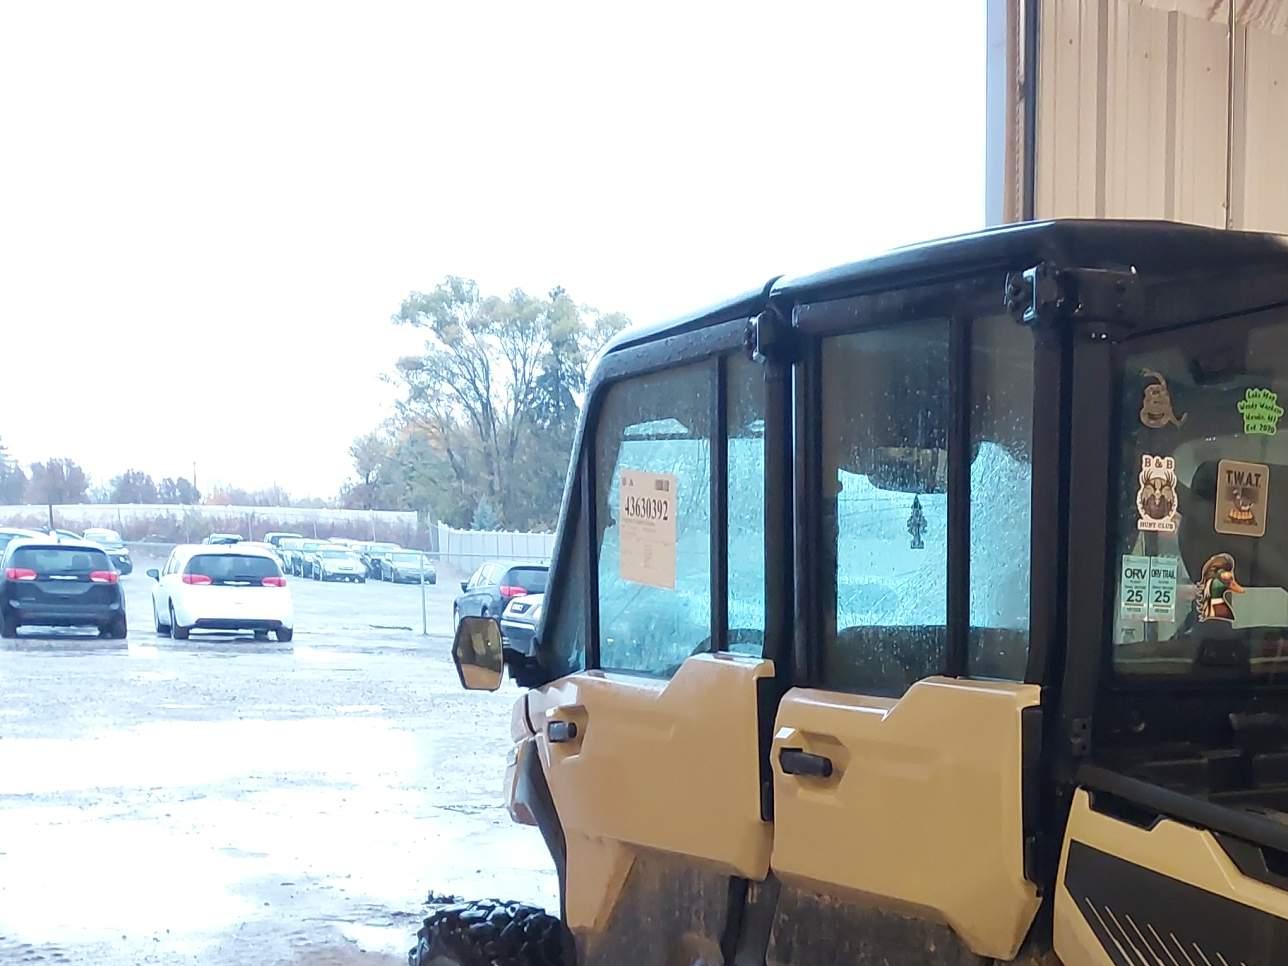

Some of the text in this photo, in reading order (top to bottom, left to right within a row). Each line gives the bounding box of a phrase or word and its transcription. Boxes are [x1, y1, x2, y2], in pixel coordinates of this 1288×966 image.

[1144, 457, 1173, 470] B & B
[624, 496, 668, 521] 43630392
[1139, 521, 1157, 529] HUNT
[1124, 567, 1147, 580] ORV
[1126, 589, 1143, 603] 25
[1154, 590, 1171, 604] 25
